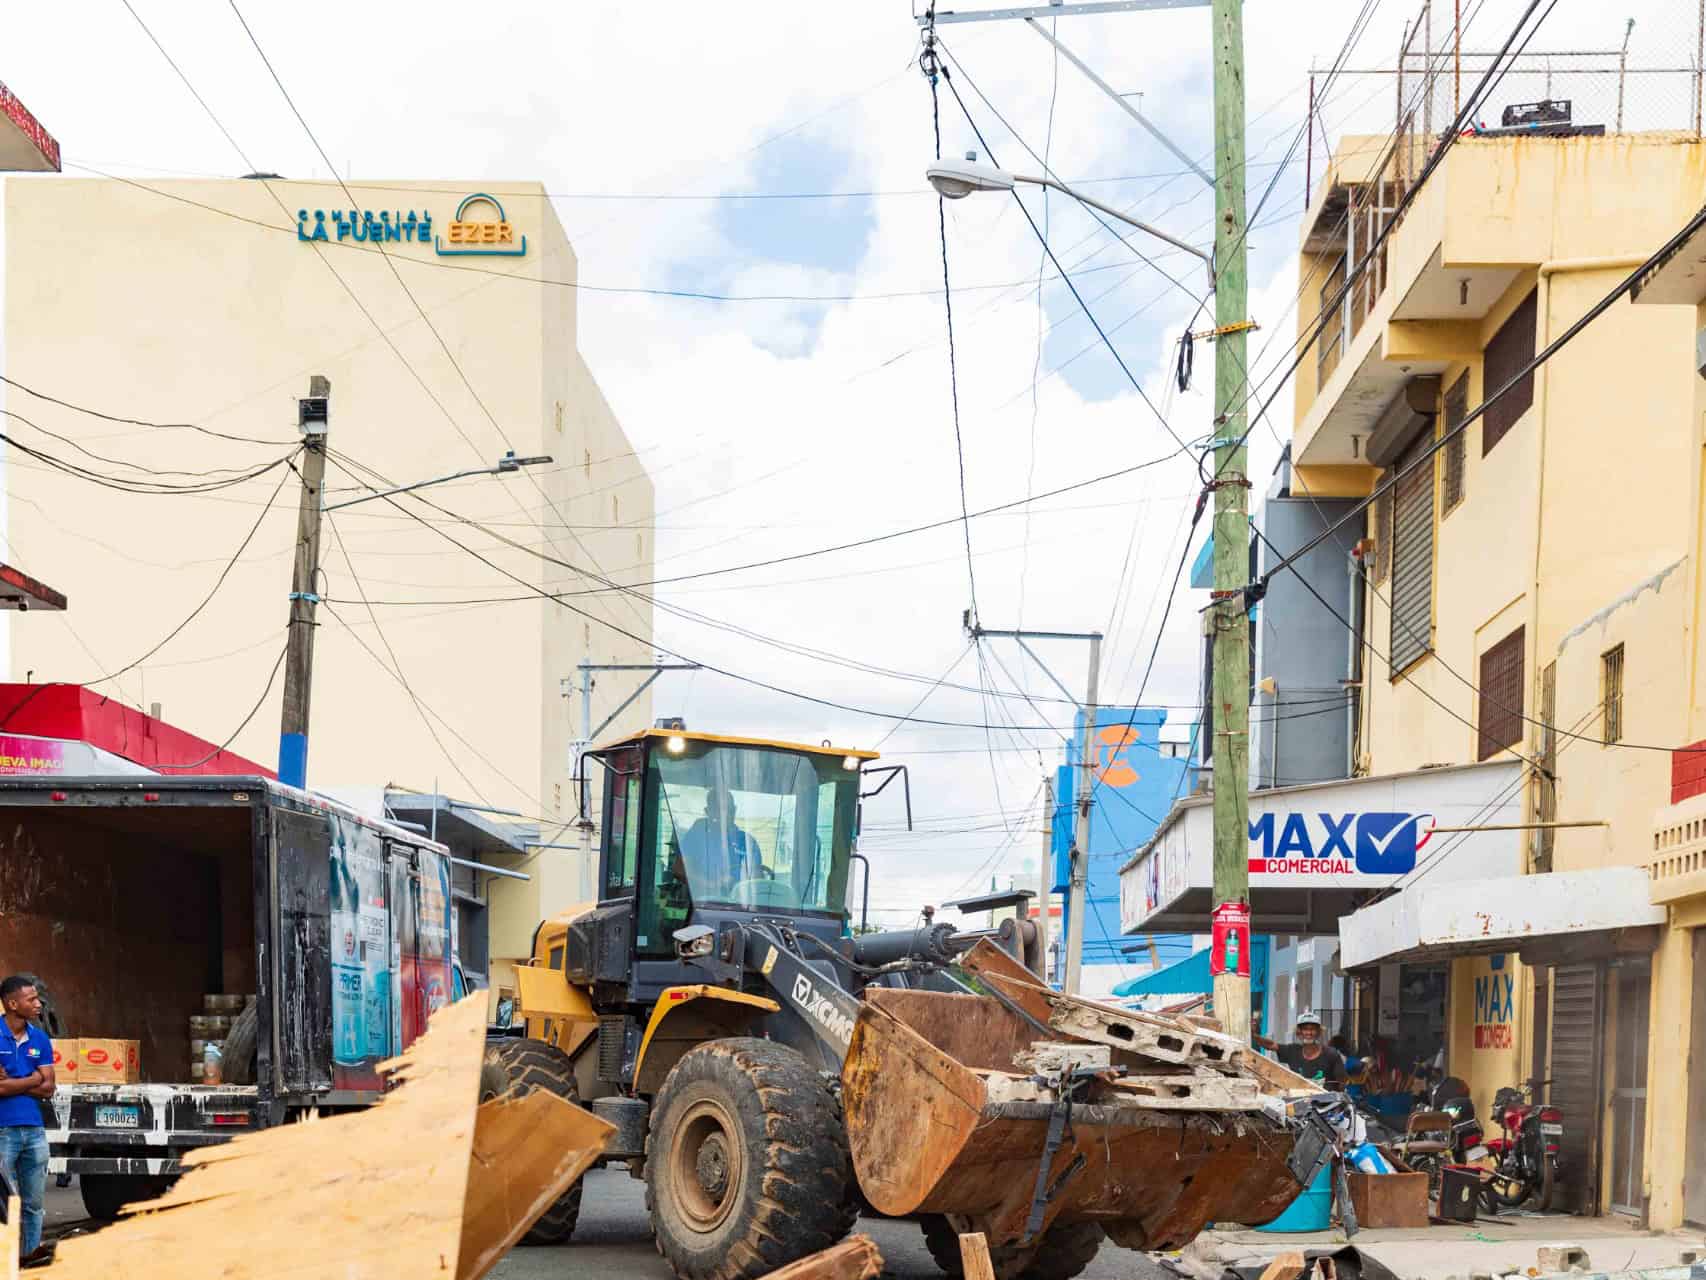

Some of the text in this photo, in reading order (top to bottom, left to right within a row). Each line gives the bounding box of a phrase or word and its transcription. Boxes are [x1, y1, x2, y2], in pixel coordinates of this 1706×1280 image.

[298, 209, 432, 223] COMERCIAL
[298, 222, 432, 242] LA FUENTE
[449, 222, 513, 244] EZER
[1248, 813, 1356, 858] MAX
[1267, 859, 1354, 874] COMERCIAL
[1475, 974, 1514, 1024] MAX
